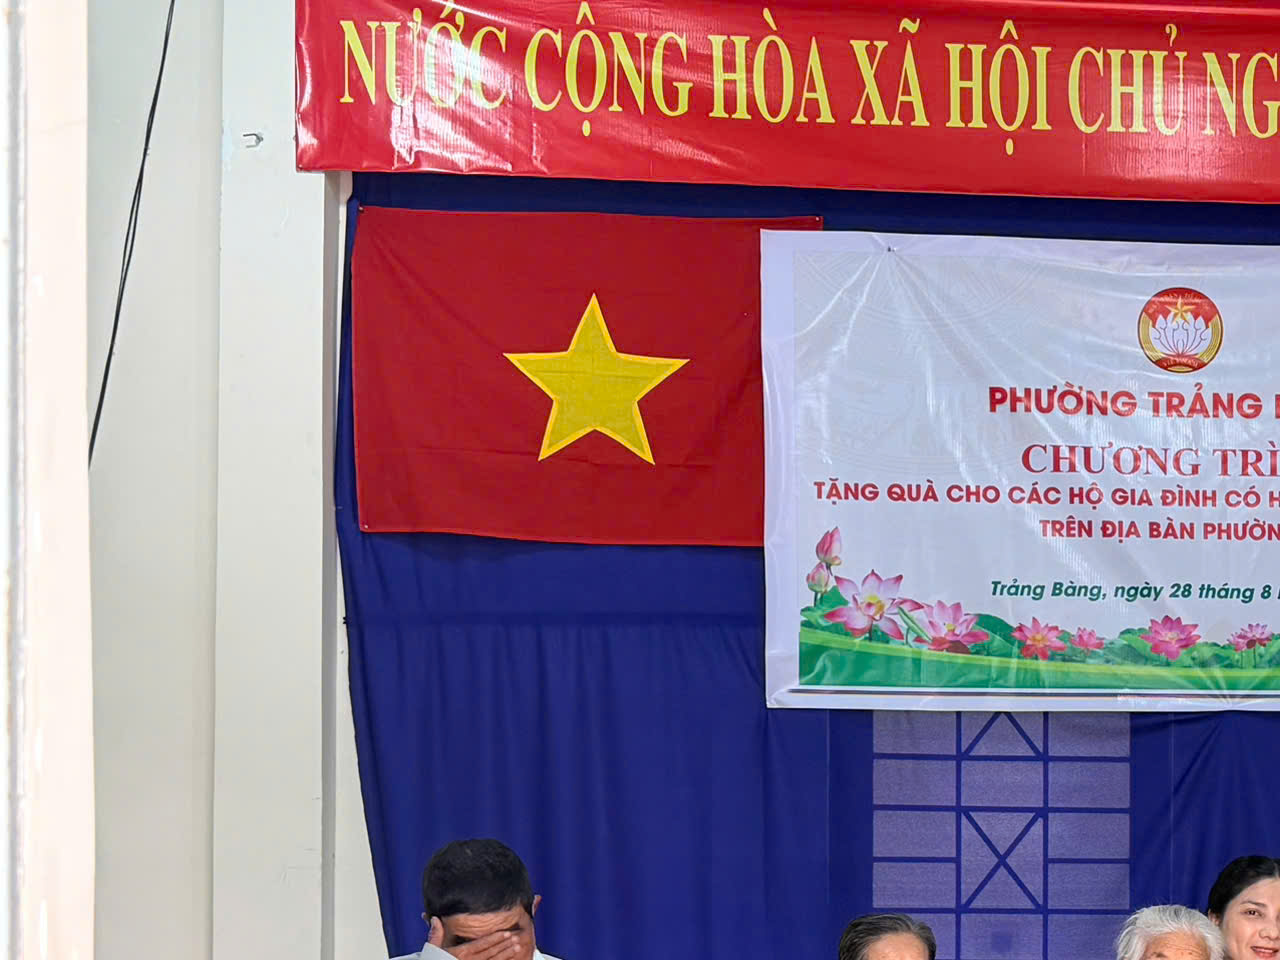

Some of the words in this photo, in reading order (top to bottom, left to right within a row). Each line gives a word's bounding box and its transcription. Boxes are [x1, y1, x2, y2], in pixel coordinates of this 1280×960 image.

[525, 2, 693, 136] CỘNG
[709, 9, 835, 125] HÒA
[851, 18, 929, 128] XÃ
[946, 20, 1052, 155] HỘI
[1069, 24, 1188, 137] CHỦ
[988, 381, 1139, 417] PHƯỜNG
[1148, 384, 1263, 420] TRẢNG
[1022, 442, 1200, 476] CHƯƠNG
[815, 477, 881, 505] TẶNG
[887, 479, 940, 504] QUÀ
[947, 485, 1001, 504] CHO
[1007, 481, 1062, 506] CÁC
[1069, 482, 1104, 511] HỘ
[1112, 488, 1153, 506] GIA
[1161, 486, 1217, 508] ĐÌNH
[1225, 487, 1262, 509] CÓ
[1040, 517, 1094, 539] TRÊN
[1101, 521, 1142, 544] ĐỊA
[1149, 518, 1195, 540] BÀN
[992, 578, 1045, 600] Trảng
[1051, 581, 1106, 601] Bàng,
[1114, 581, 1164, 602] ngày
[1169, 583, 1192, 598] 28
[1199, 583, 1255, 604] tháng
[1261, 585, 1272, 599] 8
